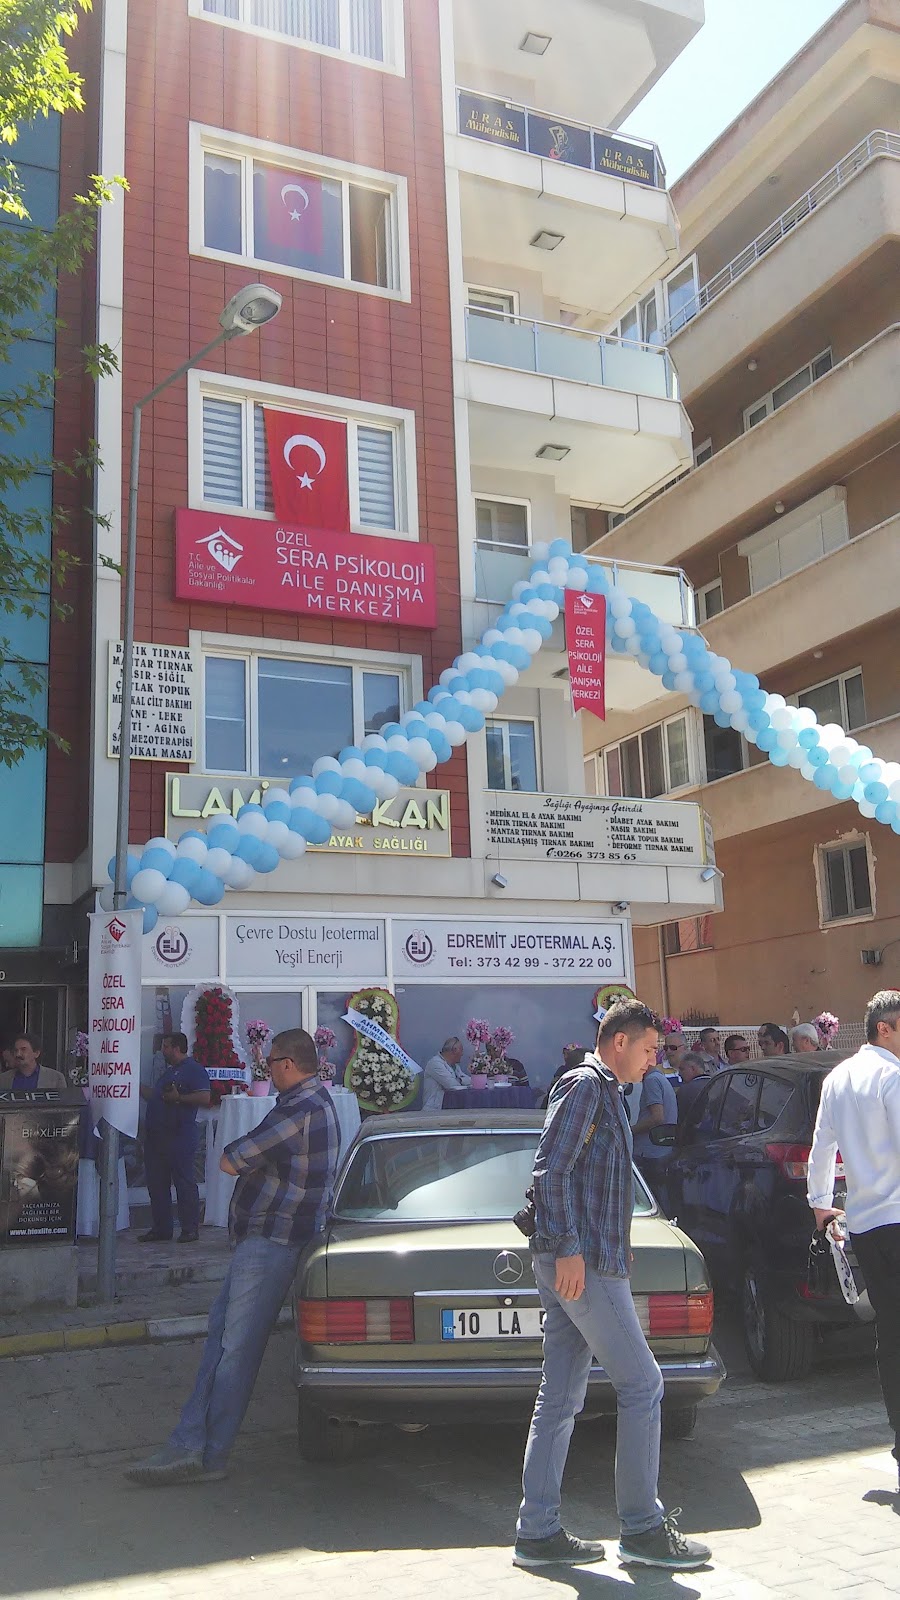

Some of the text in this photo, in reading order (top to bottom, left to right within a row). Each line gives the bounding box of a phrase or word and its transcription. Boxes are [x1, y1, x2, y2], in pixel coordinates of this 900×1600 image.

[471, 110, 514, 130] URAS
[466, 119, 520, 142] Mühendislik
[605, 148, 644, 168] URAS
[600, 157, 650, 180] Mühendislik
[275, 528, 312, 547] ÖZEL
[189, 562, 204, 570] Aile
[276, 547, 425, 585] SERA PSİKOLOJİ
[188, 570, 256, 585] Sosyal Politikalar
[281, 571, 424, 604] AİLE DANIŞMA
[307, 594, 400, 618] MERKEZİ
[576, 626, 594, 636] ÖZEL
[576, 640, 594, 648] SERA
[116, 644, 190, 660] BIK TIRNAK
[568, 650, 602, 662] PSİKOLOJİ
[113, 656, 193, 672] MTAR TIRNAK
[576, 664, 592, 674] AİLE
[116, 680, 190, 696] ÇLAK TOPUK
[112, 694, 192, 710] MEKAL CİLT BAKIMI
[158, 712, 182, 722] LEKE
[154, 723, 186, 734] AGİNG
[132, 734, 193, 747] MEZOTERAPİSİ
[112, 745, 192, 760] MDİKAL MASAJ
[543, 798, 643, 814] Sağlığı Ayağınıza Getirdik
[490, 808, 520, 819] MEDİKAL
[531, 812, 536, 820] &
[538, 812, 556, 821] AYAK
[558, 814, 582, 822] BAKIMI
[490, 818, 565, 830] BATIK TIRNAK BAKIMI
[633, 826, 656, 834] BAKIMI
[636, 818, 652, 826] AYAK
[656, 819, 679, 828] BAKIMI
[490, 827, 574, 838] MANTAR TIRNAK BAKIMI
[638, 834, 660, 843] TOPUK
[661, 836, 684, 844] BAKIMI
[328, 834, 428, 851] AYAK SAĞLIĞI
[492, 836, 594, 848] KALINLAŞMIŞ TIRNAK BAKIMI
[612, 842, 694, 853] DEFORME TIRNAK BAKIMI
[587, 851, 606, 859] 373
[608, 852, 620, 860] 85
[236, 924, 379, 944] Çevre Dostu Jeotermal
[447, 931, 616, 954] EDREMİT JEOTERMAL A.Ş.
[275, 949, 342, 968] Yeşil Enerji
[448, 956, 472, 968] Tel:
[477, 957, 500, 968] 373
[505, 957, 520, 968] 42
[524, 957, 540, 968] 99
[552, 958, 574, 968] 372
[579, 958, 594, 968] 22
[598, 958, 612, 968] 00
[103, 972, 126, 988] ÖZEL
[102, 996, 124, 1010] SERA
[92, 1015, 135, 1033] PSİKOLOJİ
[360, 1019, 390, 1041] AHMET
[100, 1040, 119, 1054] AİLE
[92, 1062, 132, 1078] DANIŞMA
[92, 1082, 130, 1098] MERKEZİ
[444, 1326, 452, 1334] TR
[458, 1312, 480, 1336] 10
[498, 1312, 522, 1334] LA
